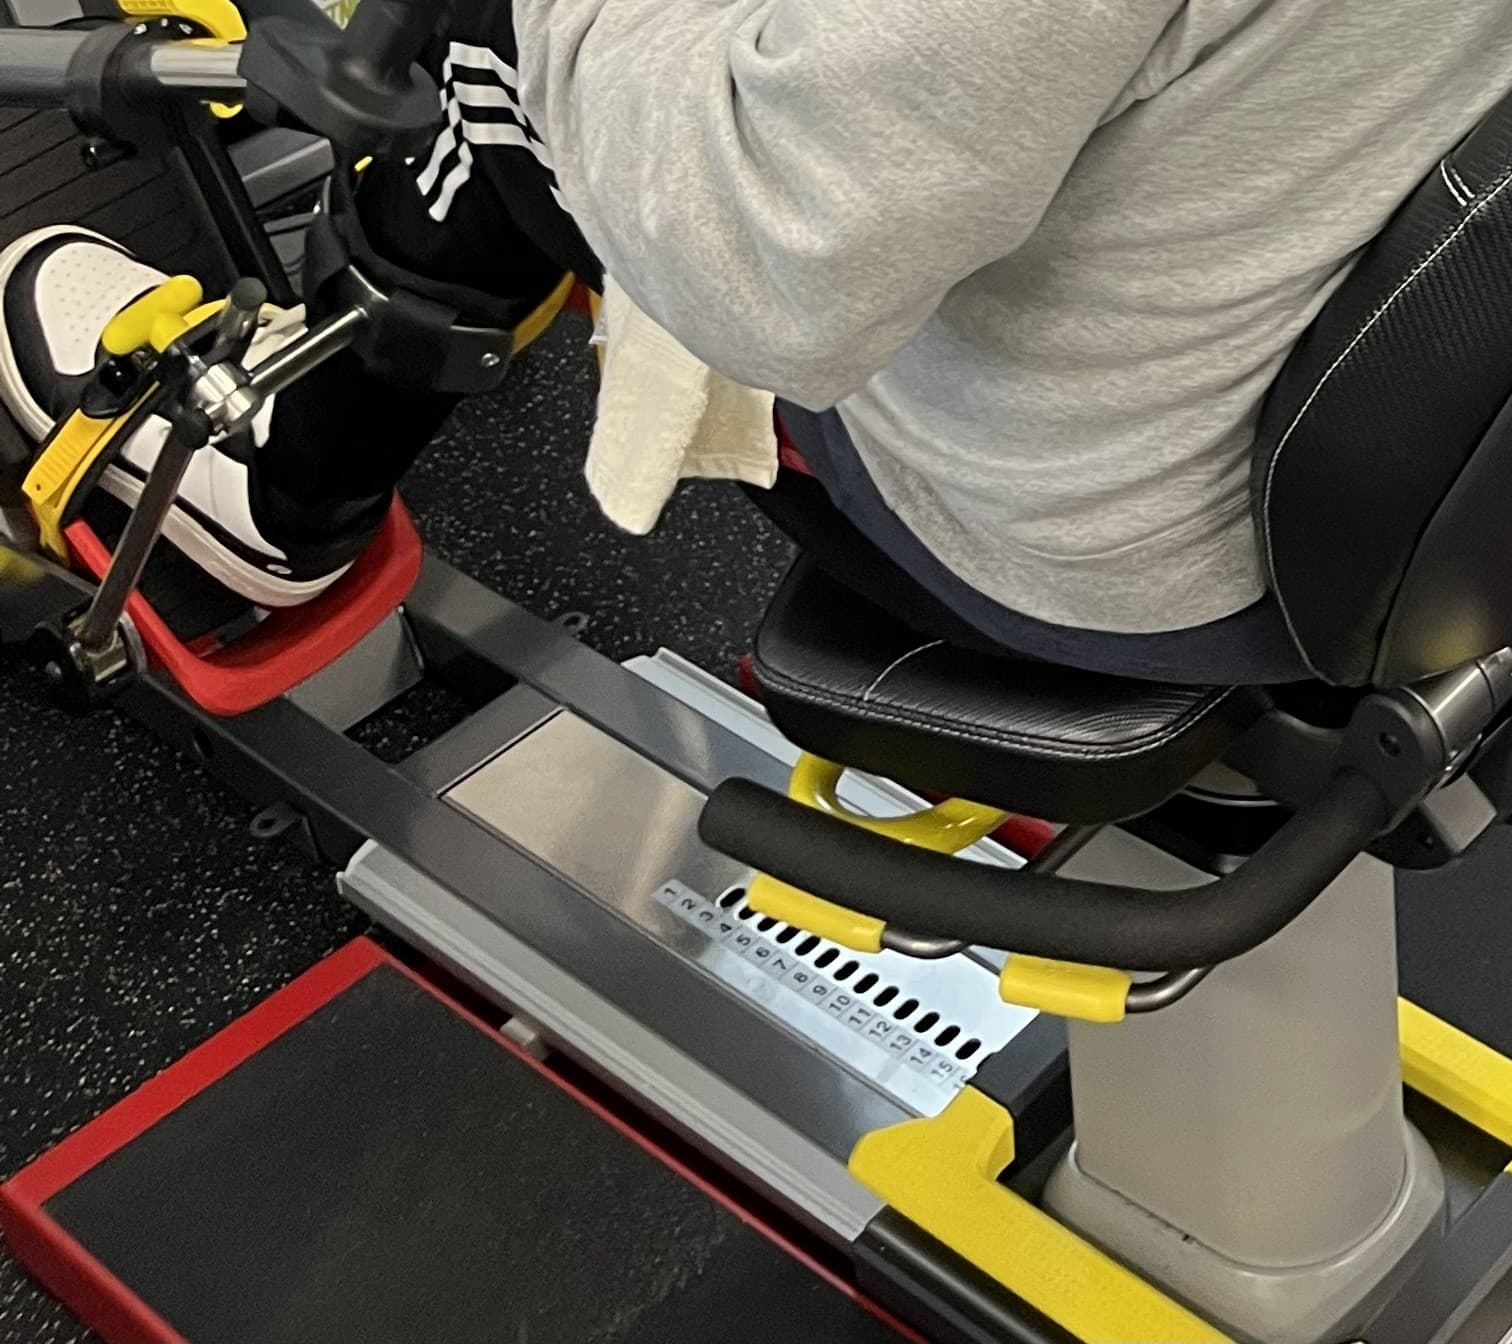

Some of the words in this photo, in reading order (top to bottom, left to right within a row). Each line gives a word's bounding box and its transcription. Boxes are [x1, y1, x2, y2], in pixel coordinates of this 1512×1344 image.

[664, 887, 677, 896] 1
[681, 898, 697, 911] 2
[719, 922, 733, 934] 4
[736, 934, 751, 947] 5
[755, 946, 770, 958] 6
[772, 958, 787, 971] 7
[793, 972, 809, 983] 8
[812, 984, 828, 996] 9
[828, 994, 851, 1012] 10
[848, 1007, 871, 1025] 11
[868, 1020, 892, 1039] 12
[890, 1034, 912, 1051] 13
[910, 1047, 933, 1065] 14
[931, 1060, 953, 1079] 15
